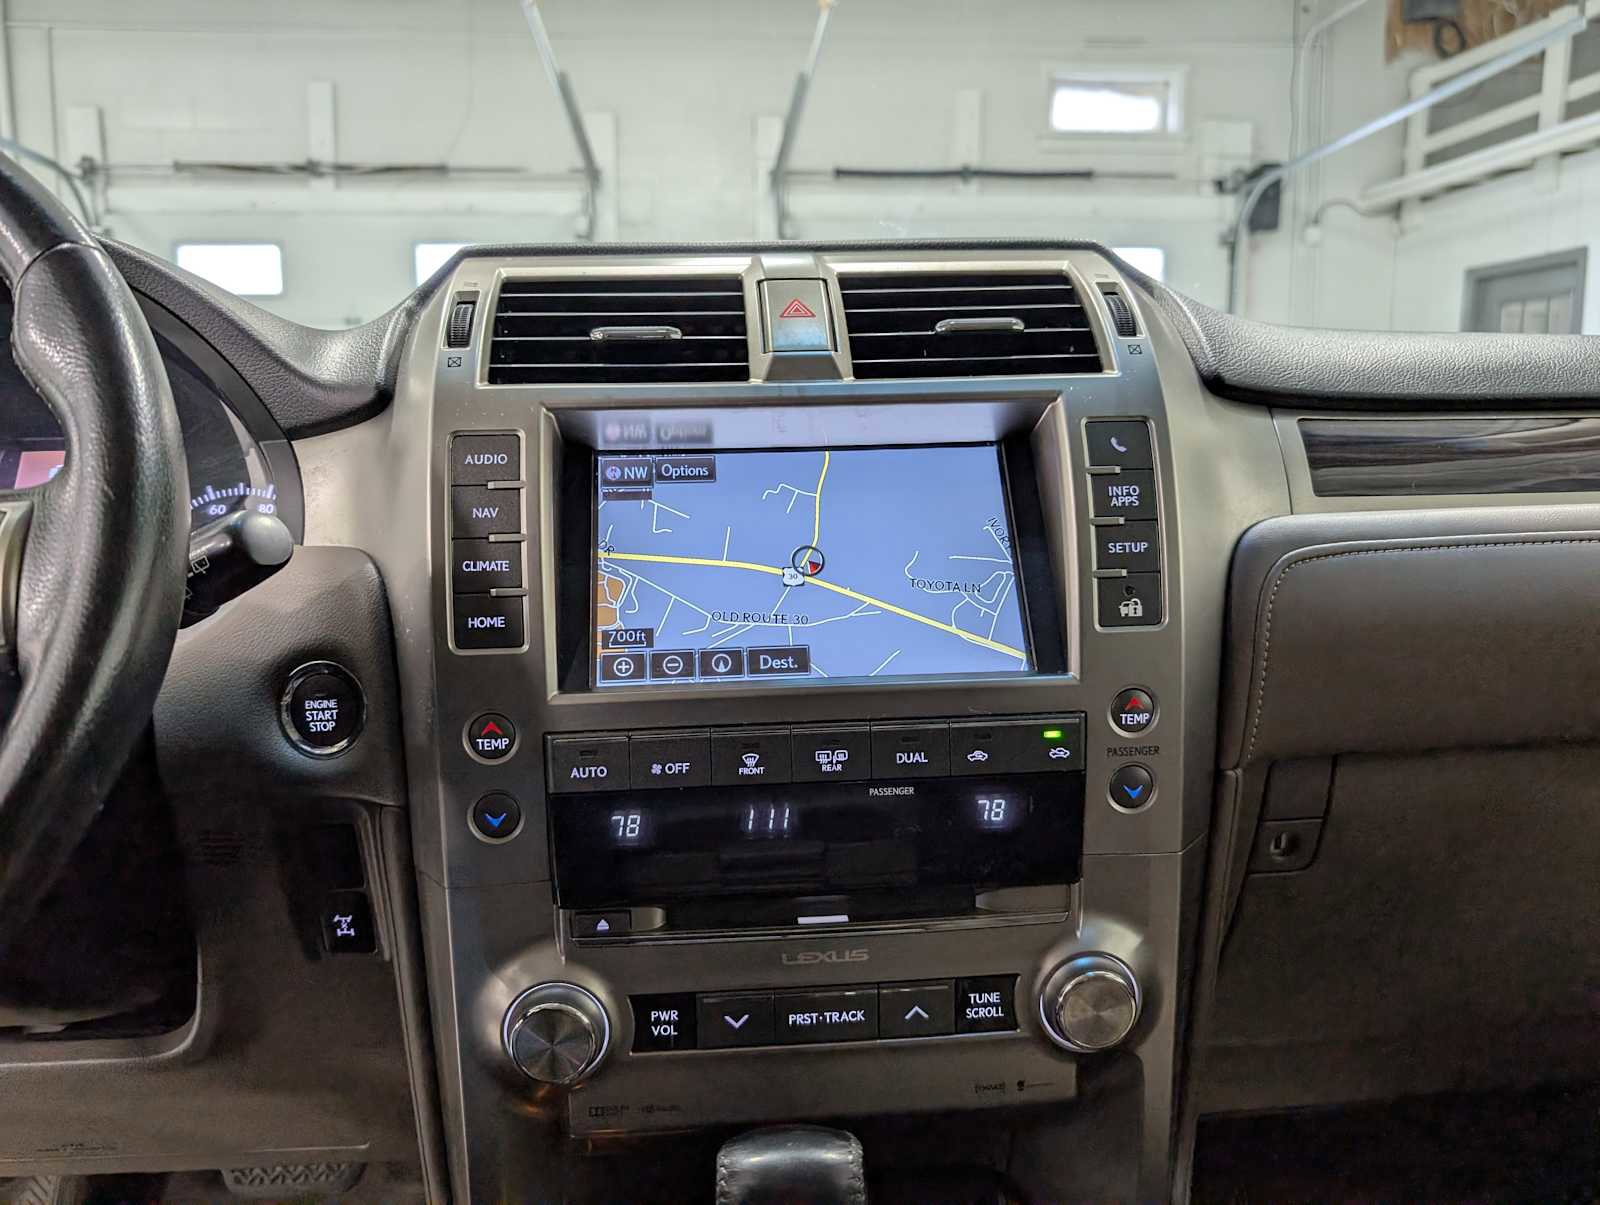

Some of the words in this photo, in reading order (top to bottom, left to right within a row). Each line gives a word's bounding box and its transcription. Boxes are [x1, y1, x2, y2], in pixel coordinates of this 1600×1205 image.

[464, 453, 508, 465] AUDIO
[624, 466, 648, 480] NW
[661, 464, 709, 479] Options
[1108, 485, 1140, 497] INFO
[1110, 496, 1140, 507] APPS
[209, 504, 226, 515] 60
[258, 503, 275, 514] 80
[472, 507, 499, 519] NAV
[1108, 542, 1149, 553] SETUP
[462, 560, 510, 572] CLIMATE
[788, 572, 799, 581] 30
[911, 578, 960, 592] TOYOTA
[964, 583, 981, 593] LN
[468, 616, 506, 629] HOME
[711, 611, 739, 623] OLD
[743, 611, 788, 624] ROUTE
[793, 614, 809, 625] 30
[609, 631, 646, 643] 700ft
[760, 655, 798, 670] Dest.
[304, 699, 338, 709] ENGINE
[306, 710, 338, 720] START
[1120, 713, 1149, 725] TEMP
[309, 721, 335, 732] STOP
[476, 738, 509, 750] TEMP
[1106, 745, 1160, 757] PASSENGER
[896, 752, 928, 764] DUAL
[570, 766, 608, 779] AUTO
[665, 763, 690, 775] OFF
[738, 766, 765, 775] FRONT
[821, 763, 842, 772] REAR
[868, 787, 915, 796] PASSENGER
[977, 799, 1006, 821] 78
[611, 814, 641, 837] 78
[782, 949, 869, 965] LEXUS
[968, 992, 1000, 1004] TUNE
[651, 1010, 679, 1022] PWR
[966, 1006, 1004, 1019] SCROLL
[651, 1024, 678, 1036] VOL
